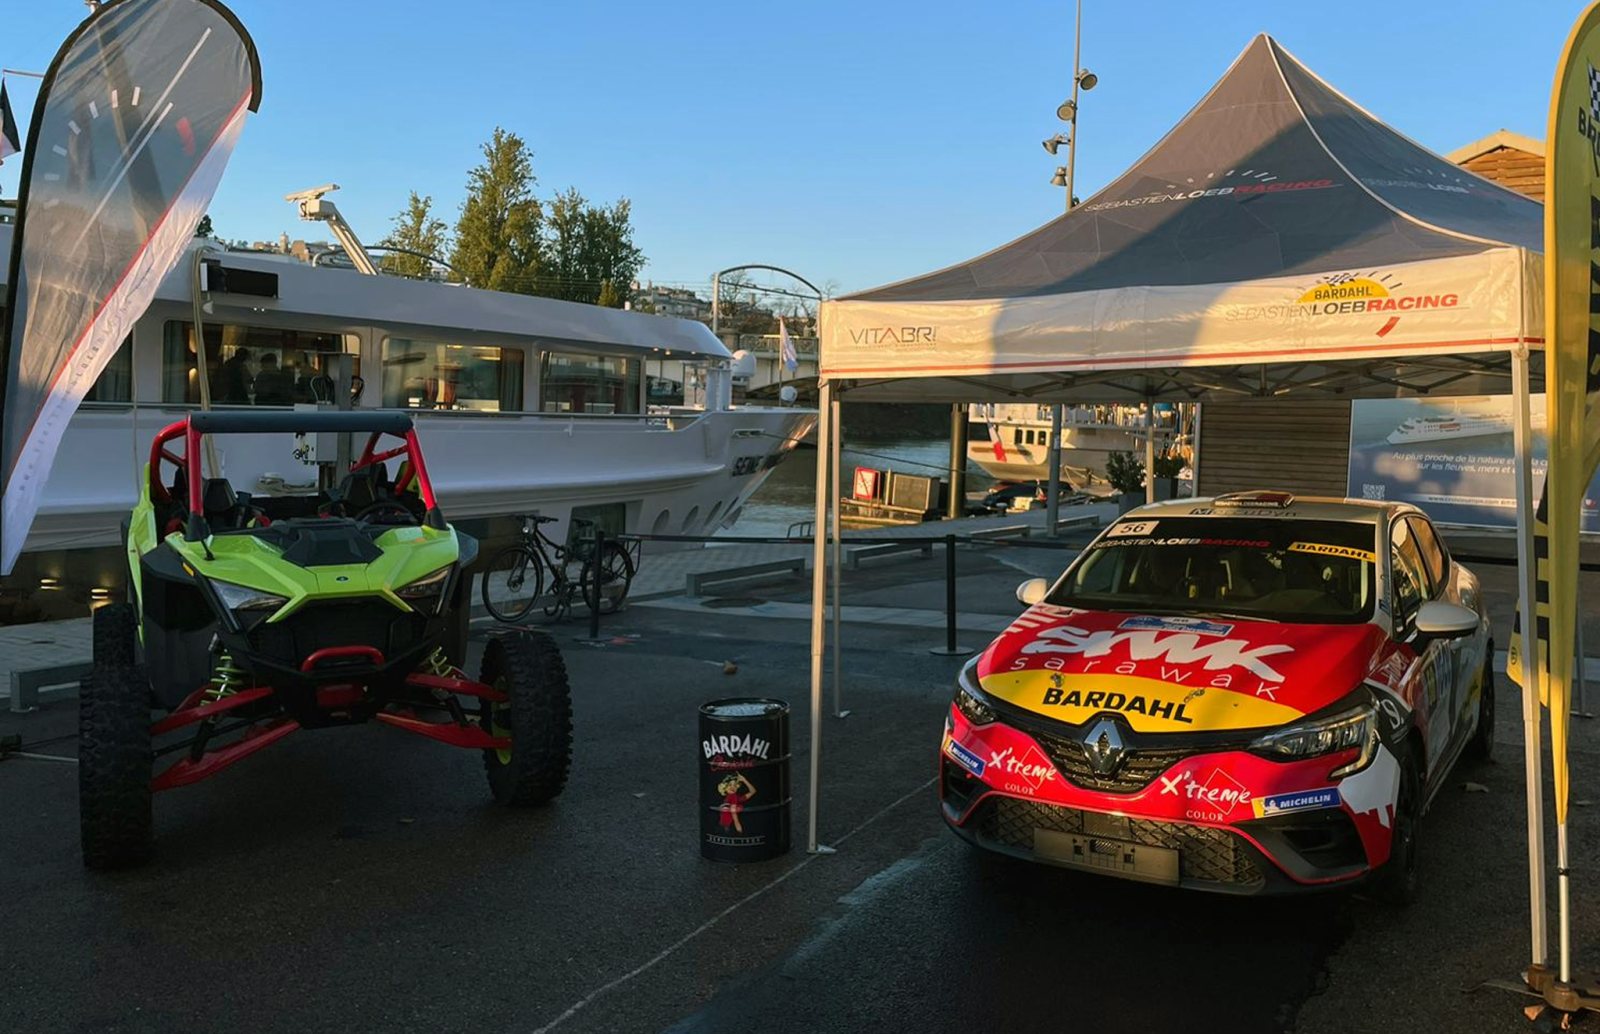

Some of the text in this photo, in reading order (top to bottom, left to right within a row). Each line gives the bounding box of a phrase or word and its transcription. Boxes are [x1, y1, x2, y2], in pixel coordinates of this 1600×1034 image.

[1314, 286, 1373, 301] BARDAHL
[1425, 454, 1454, 464] proche
[1455, 455, 1467, 463] de
[1477, 456, 1506, 465] nature
[1120, 523, 1145, 534] 56
[1294, 542, 1372, 559] BARDAHL
[1010, 657, 1280, 701] sarawak
[1042, 688, 1197, 724] BARDAHL
[702, 733, 771, 760] BARDAHL
[952, 743, 979, 769] MICHELIN
[988, 747, 1058, 781] X'treme
[1004, 782, 1035, 796] COLOR
[1160, 770, 1251, 804] X'treme
[1280, 794, 1332, 809] MICHELIN
[1186, 809, 1225, 822] COLOR
